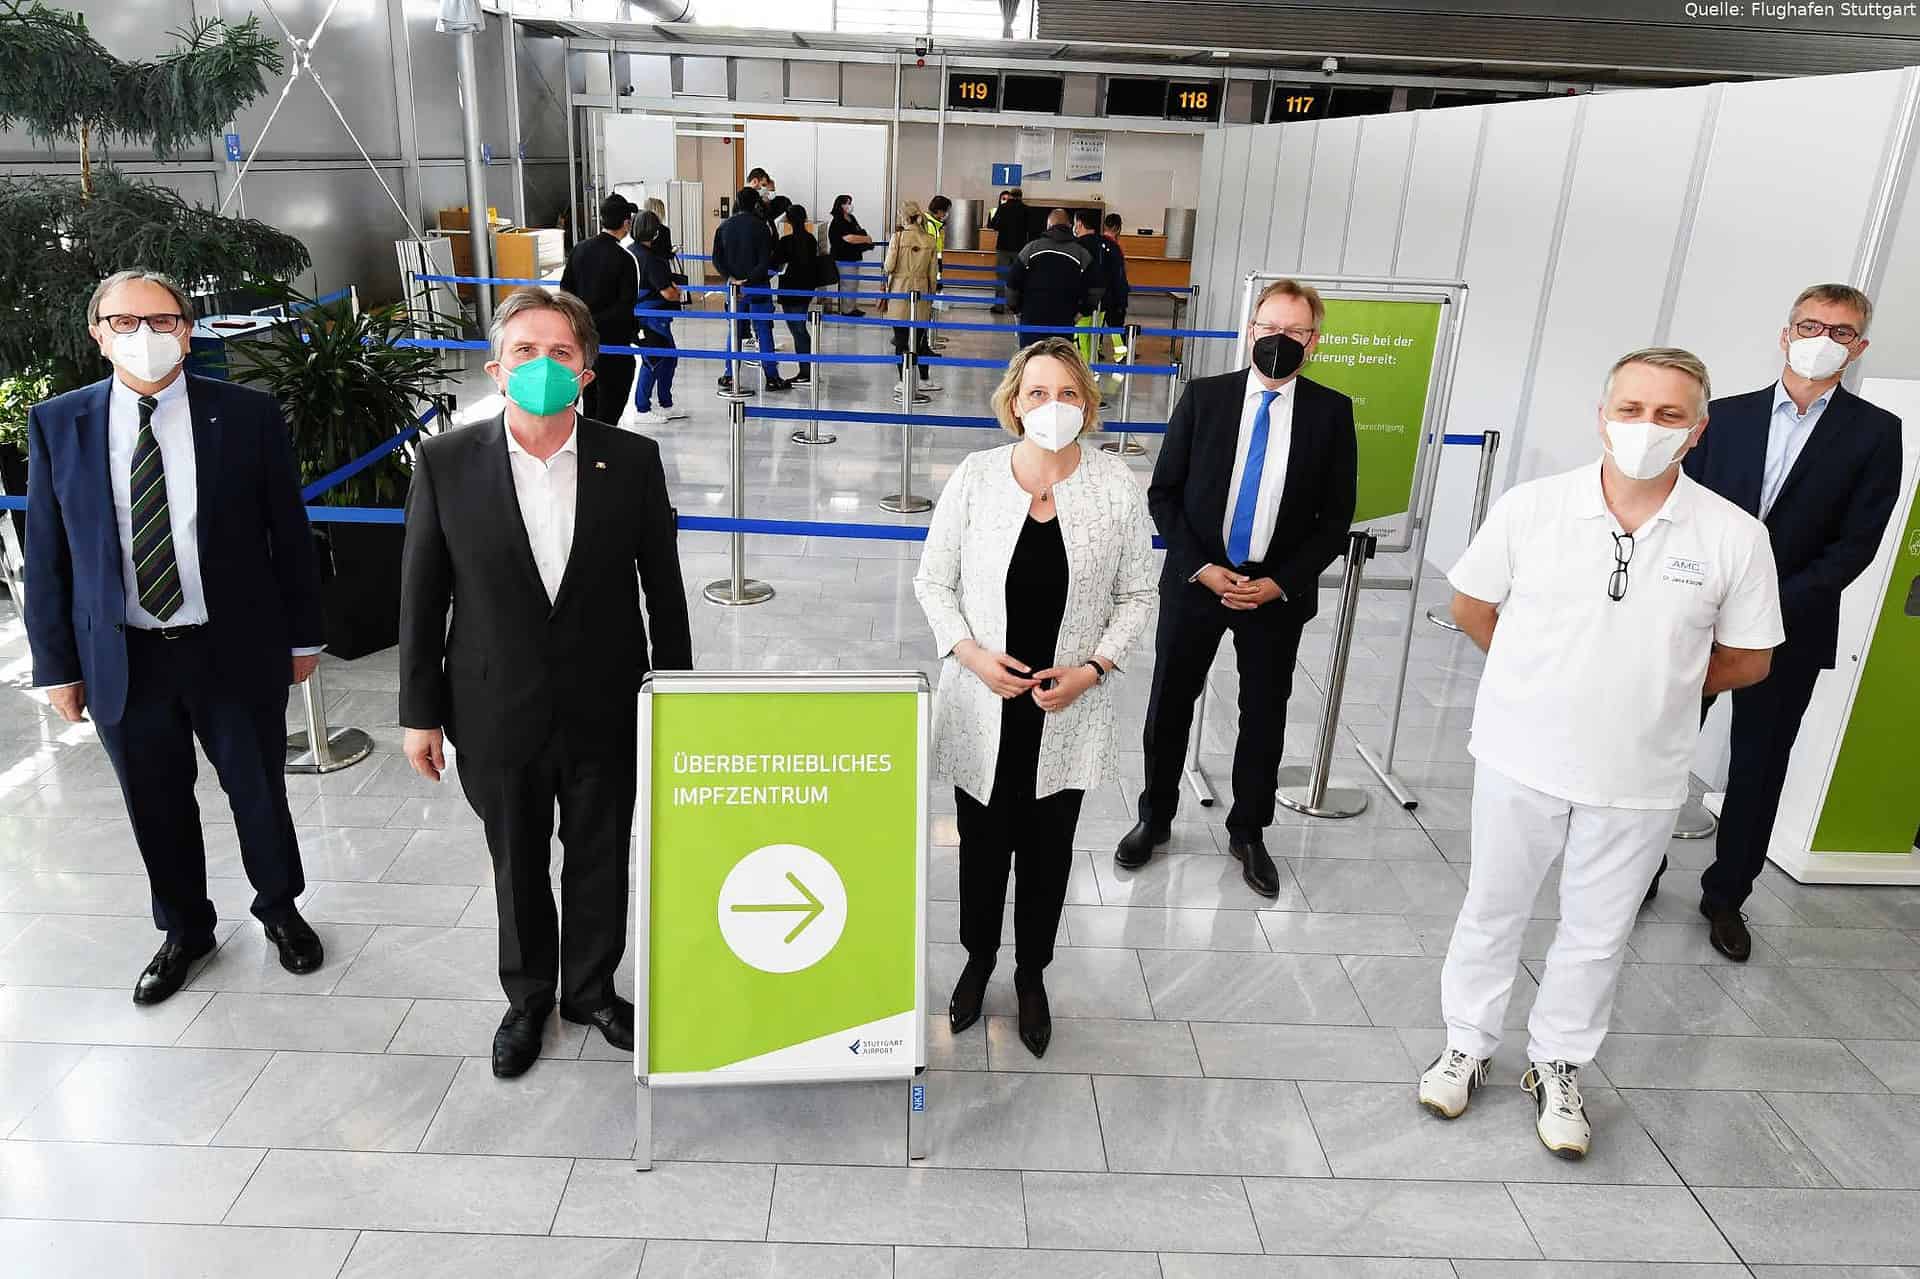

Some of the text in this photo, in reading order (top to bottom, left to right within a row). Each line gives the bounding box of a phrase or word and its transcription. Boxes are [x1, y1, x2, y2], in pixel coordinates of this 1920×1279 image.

[960, 82, 988, 99] 119
[1179, 91, 1208, 108] 118
[1286, 96, 1314, 113] 117
[1003, 167, 1010, 185] 1
[1318, 333, 1414, 347] alten Sie bei der
[1359, 352, 1397, 365] bereit:
[673, 751, 892, 773] ÜBERBETRIEBLICHES
[673, 786, 829, 806] IMPFZENTRUM
[863, 1040, 903, 1048] STUTTGART
